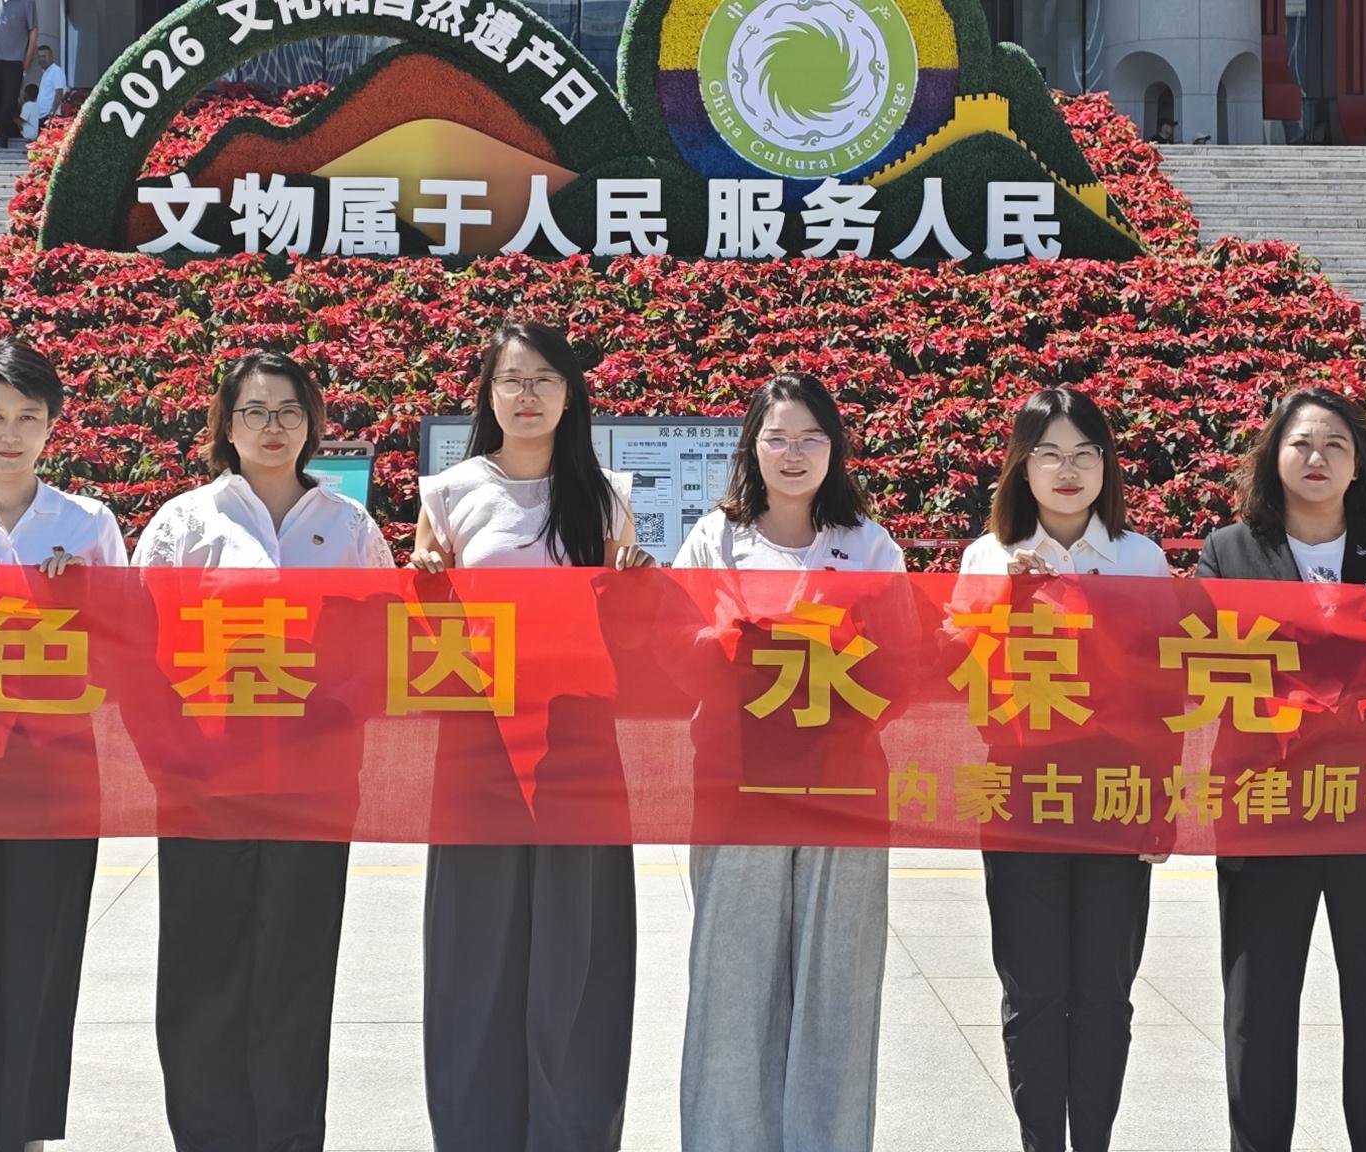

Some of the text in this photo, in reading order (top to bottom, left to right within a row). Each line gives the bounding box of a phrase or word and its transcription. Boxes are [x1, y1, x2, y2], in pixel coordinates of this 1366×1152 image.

[100, 26, 205, 138] 2026
[708, 80, 907, 170] China Cultural Heritage
[136, 172, 1062, 259] 文物属于人民 服务人民
[658, 427, 739, 438] 观众预约流程
